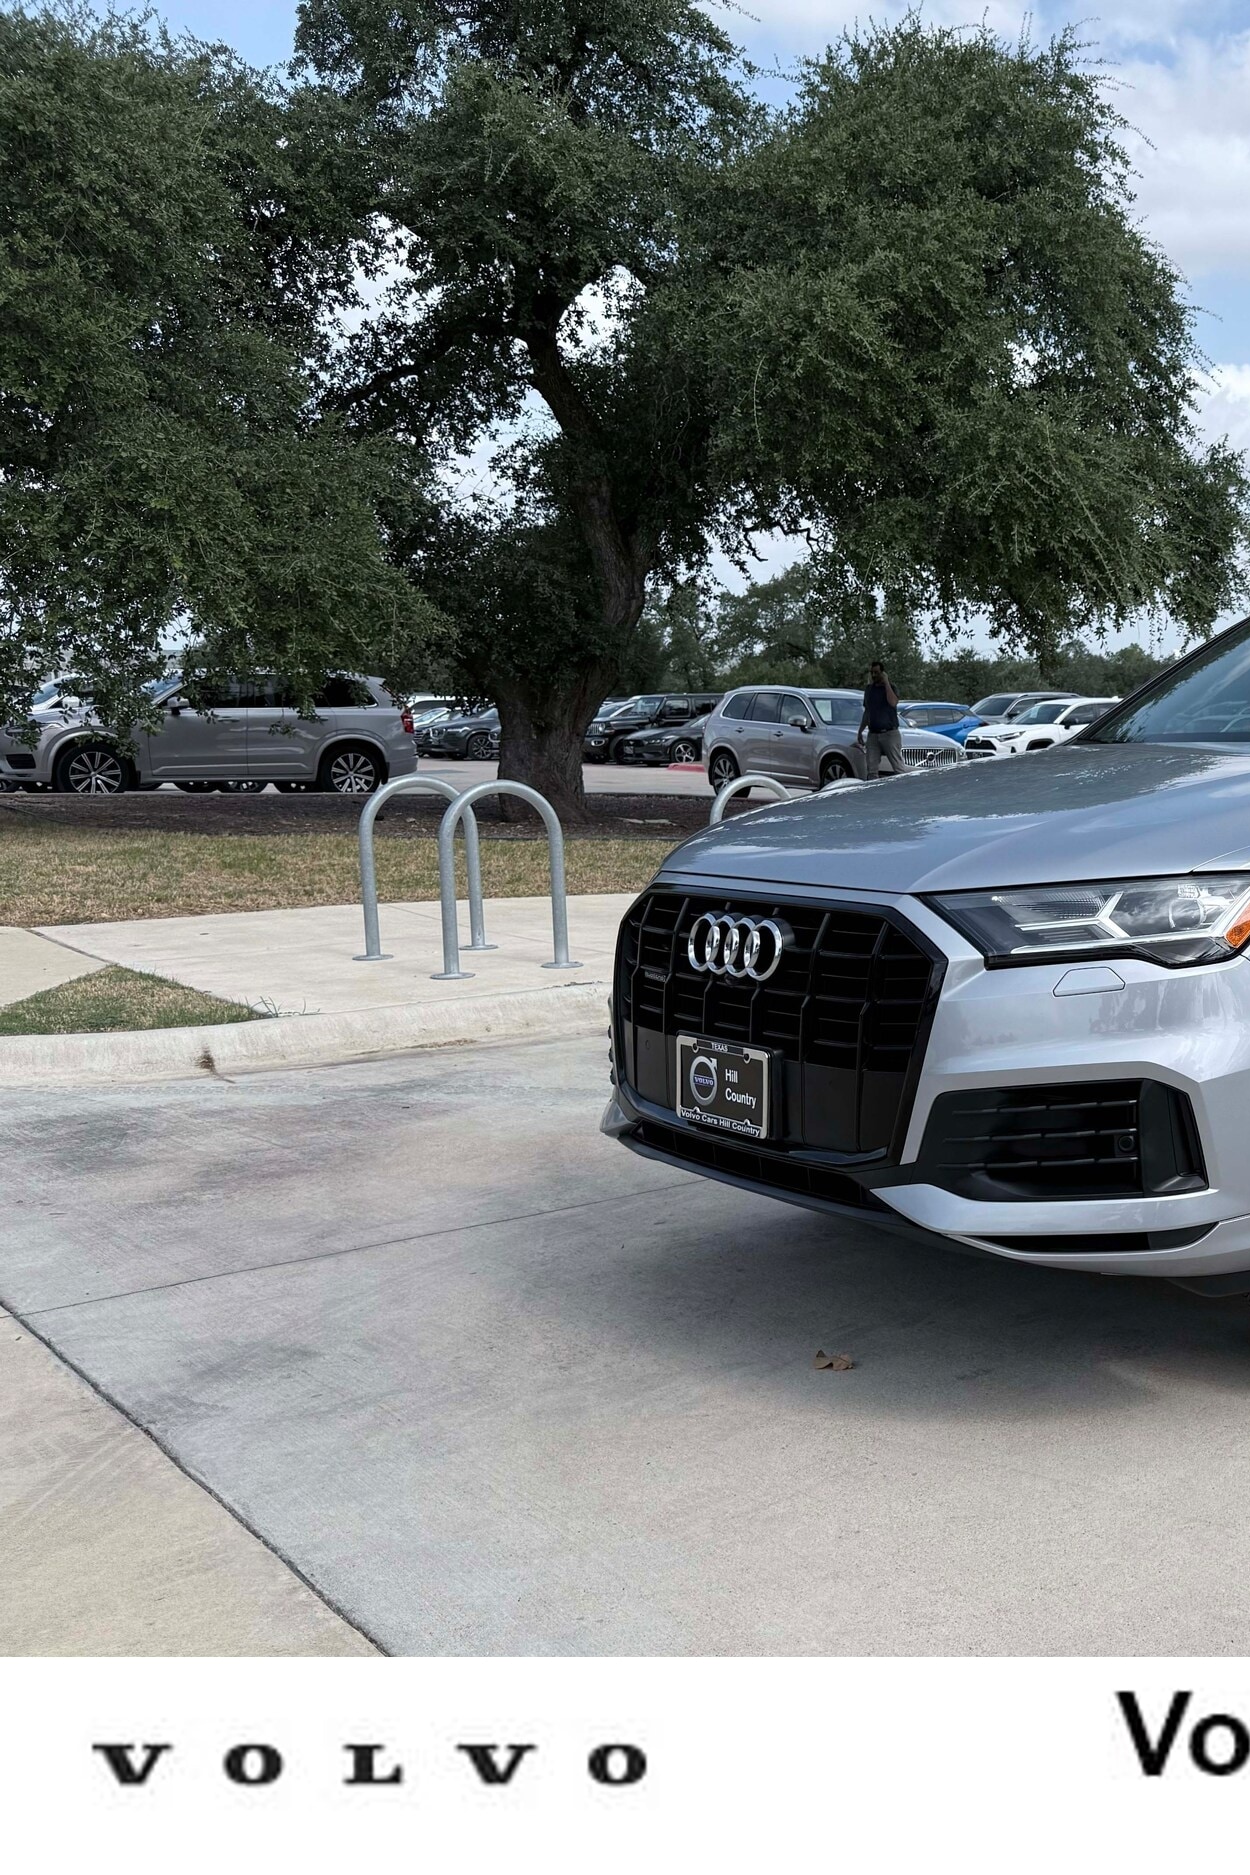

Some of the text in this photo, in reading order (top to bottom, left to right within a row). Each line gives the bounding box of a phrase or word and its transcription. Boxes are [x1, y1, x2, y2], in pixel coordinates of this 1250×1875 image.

[711, 1042, 728, 1053] TEXAS
[694, 1076, 714, 1086] VOLVO
[725, 1068, 738, 1083] Hill
[725, 1087, 757, 1109] Country
[681, 1110, 760, 1137] Volvo Cars Hill Country
